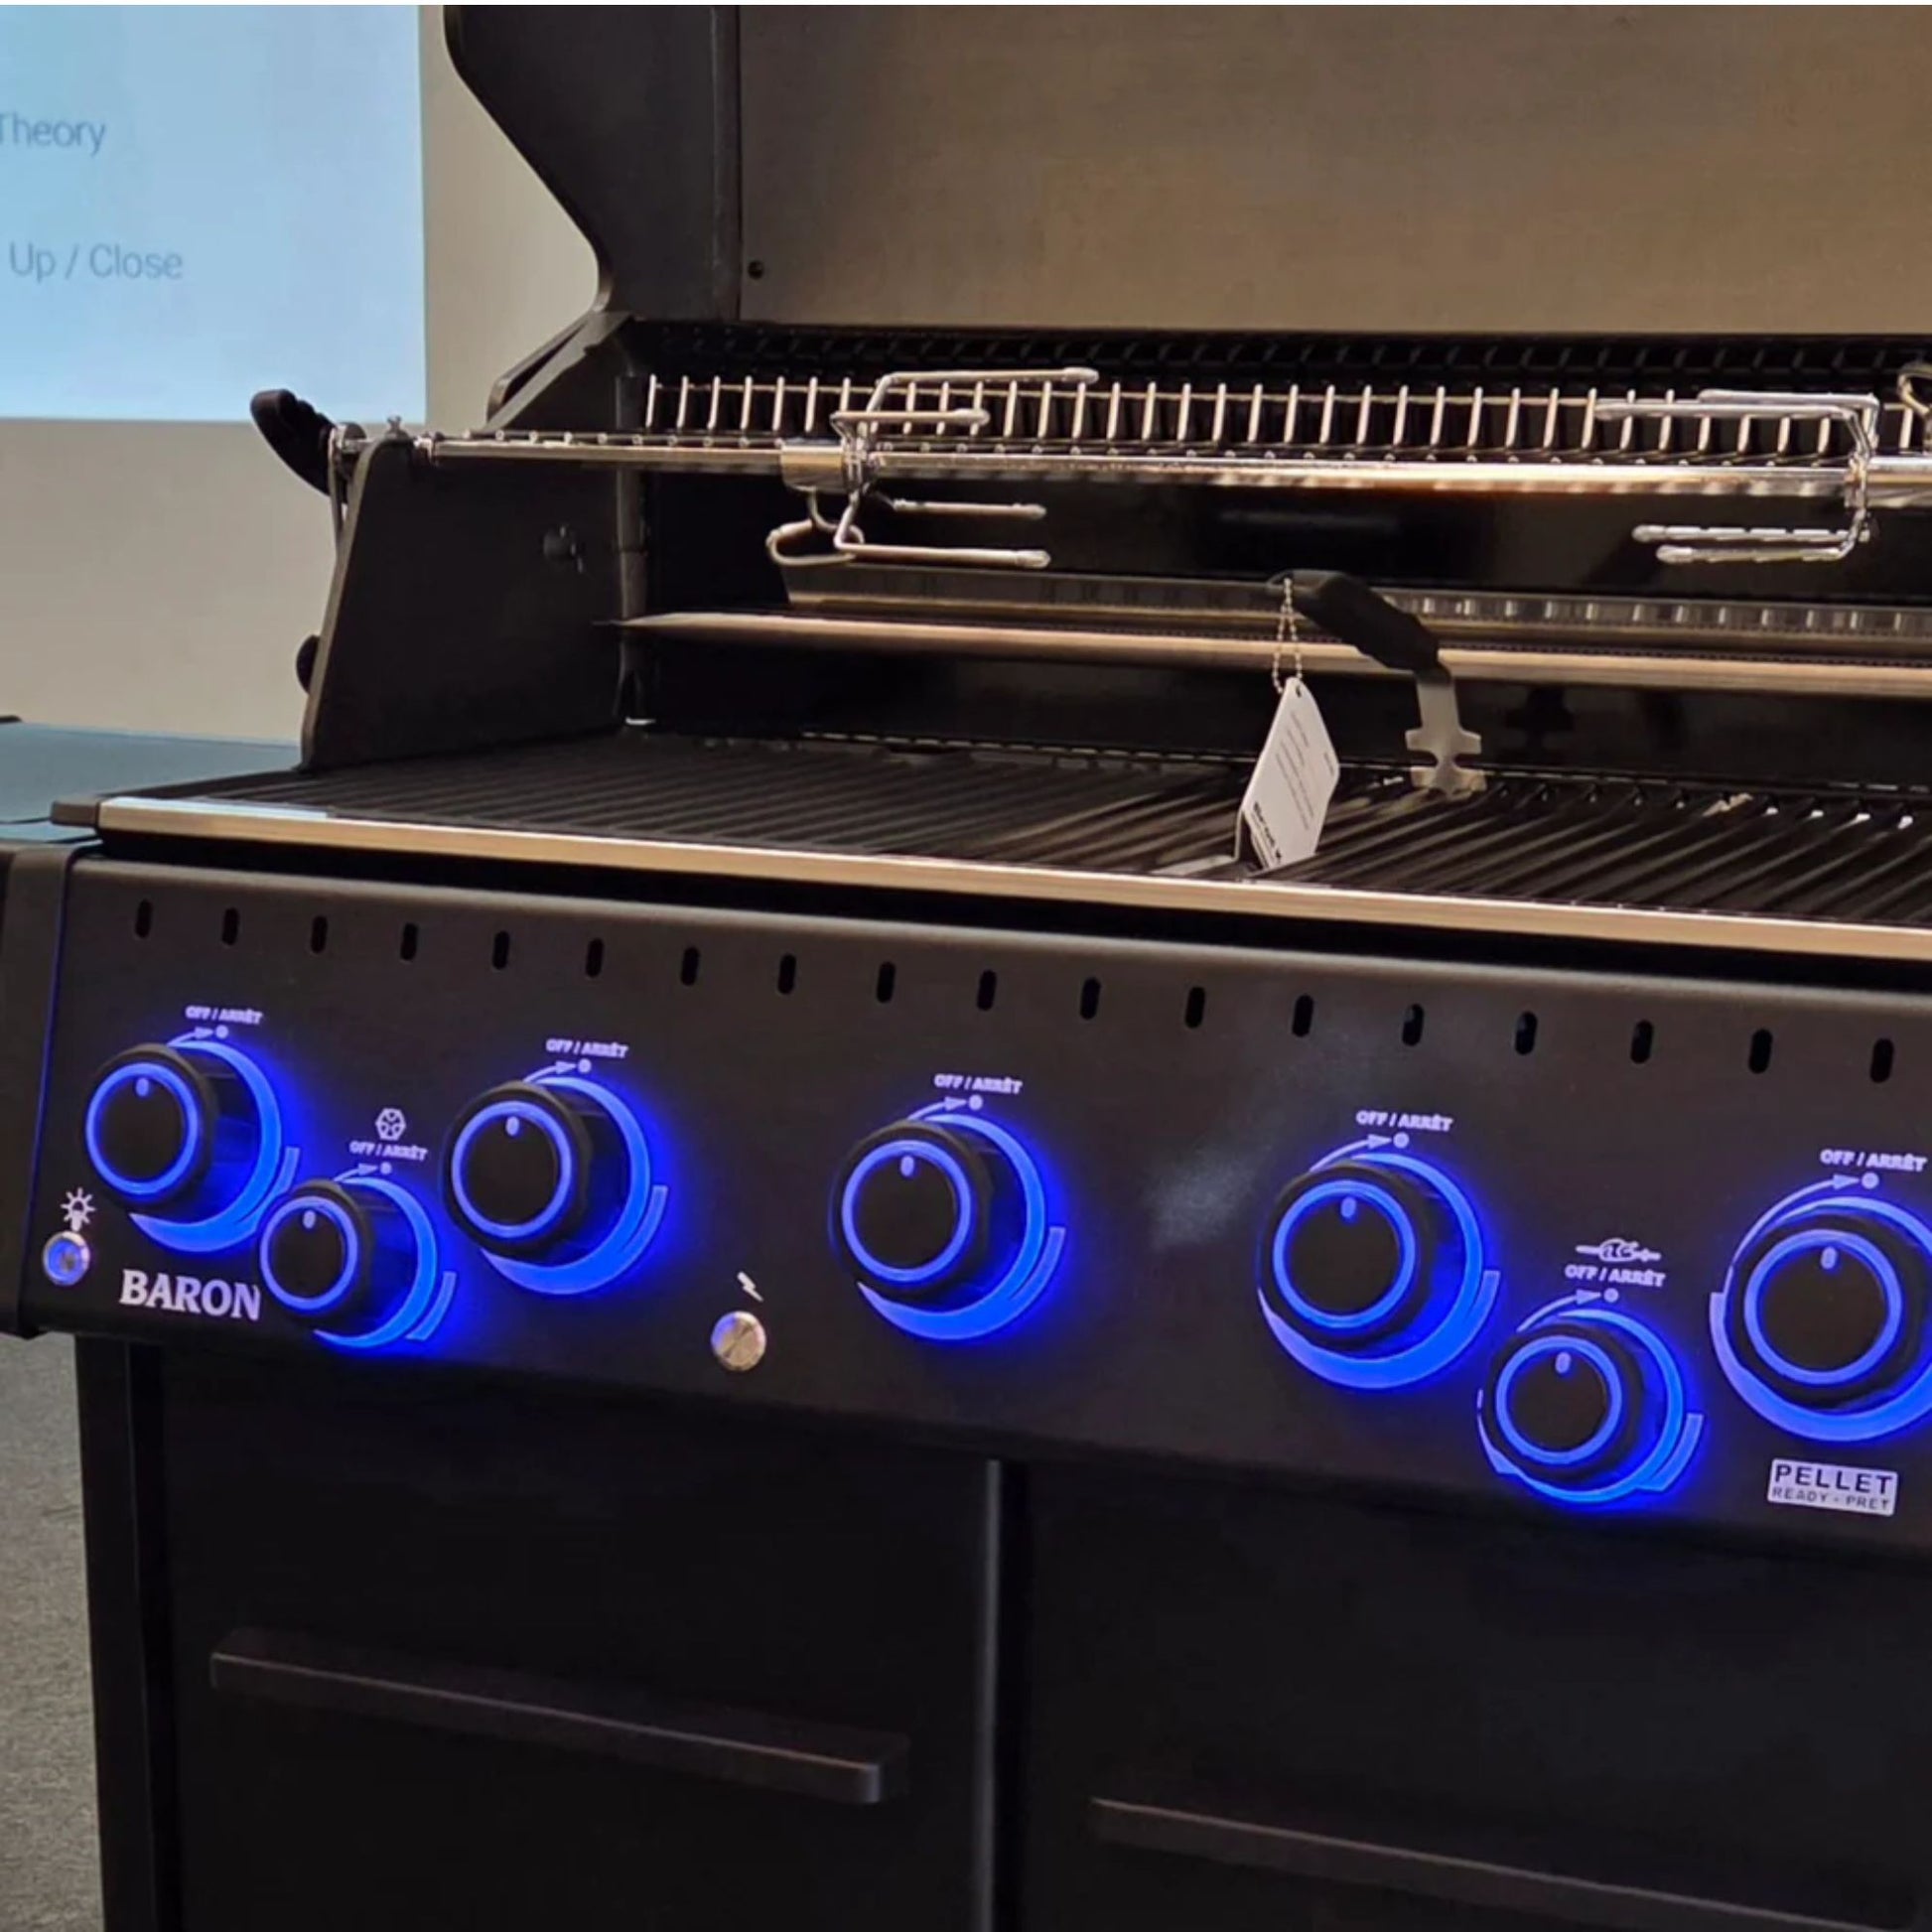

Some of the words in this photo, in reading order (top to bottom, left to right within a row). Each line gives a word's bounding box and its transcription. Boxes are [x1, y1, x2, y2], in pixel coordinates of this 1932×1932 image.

[0, 111, 106, 158] Theory
[9, 241, 57, 284] Up
[65, 244, 79, 280] /
[89, 243, 184, 280] Close
[119, 1268, 261, 1321] BARON
[1772, 1486, 1829, 1503] READY
[1775, 1463, 1893, 1495] PELLET
